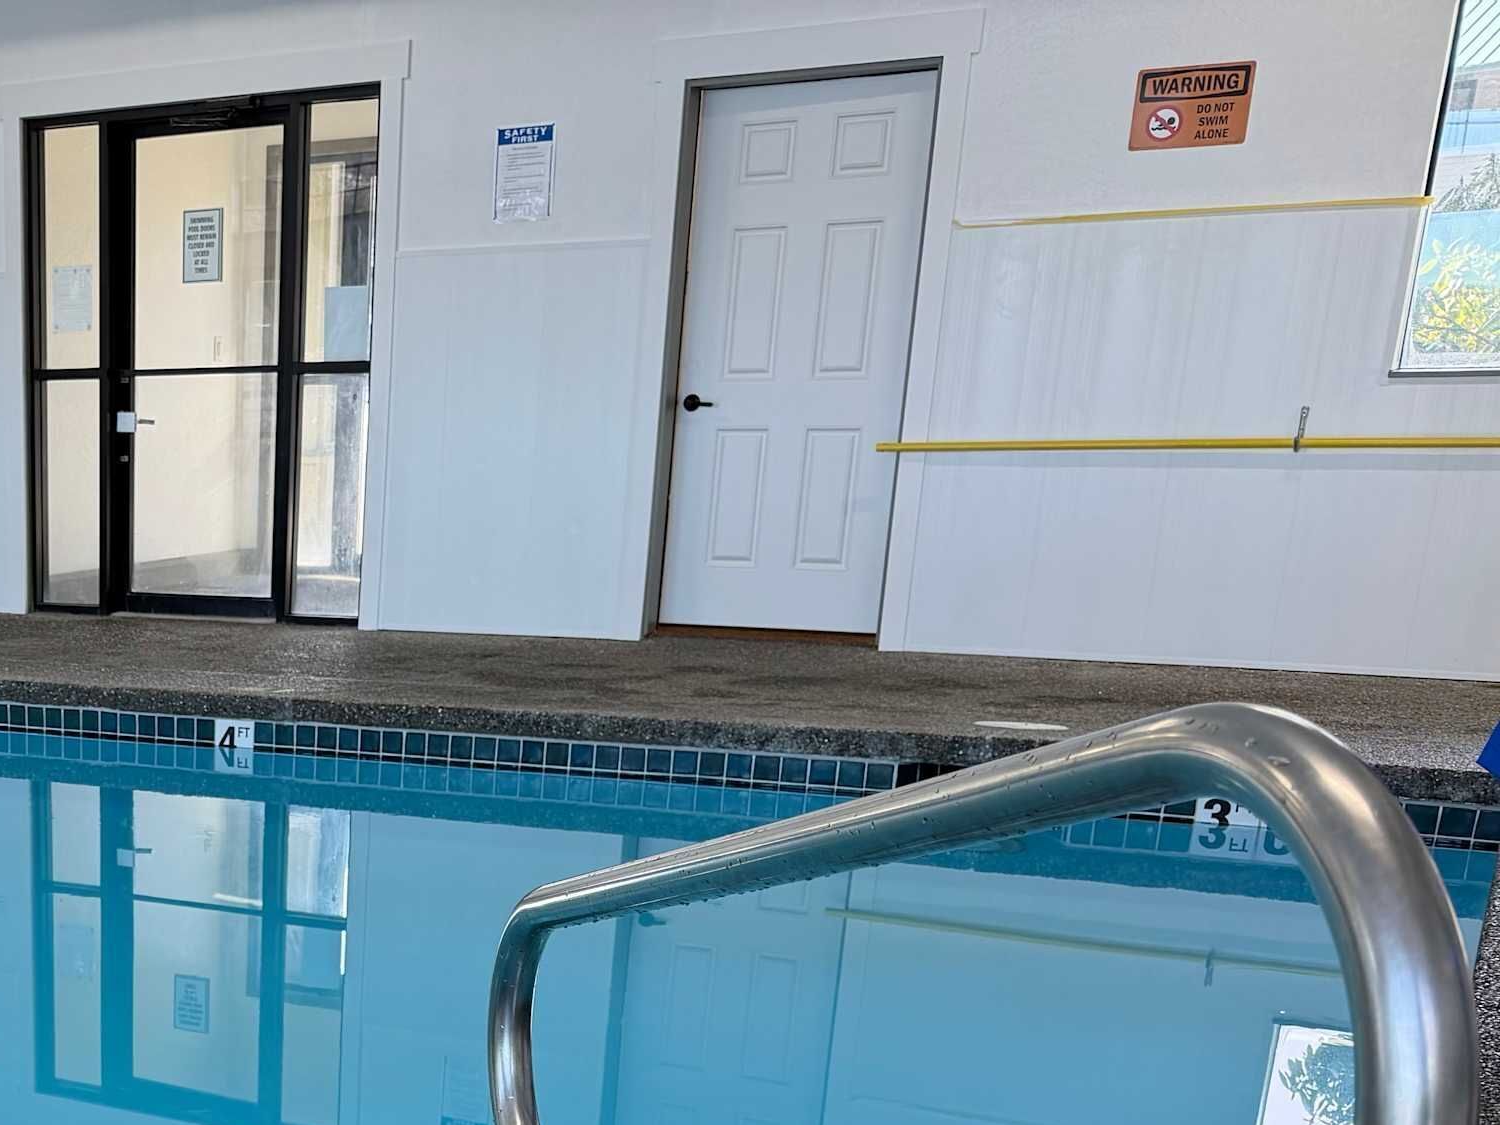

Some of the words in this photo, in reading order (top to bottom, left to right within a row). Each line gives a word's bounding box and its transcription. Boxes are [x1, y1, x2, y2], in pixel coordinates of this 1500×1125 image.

[1153, 73, 1240, 96] WARNING
[1197, 104, 1211, 114] DO
[1213, 102, 1235, 113] NOT
[1198, 115, 1229, 127] SWIM
[504, 127, 548, 140] SAFETY
[511, 134, 539, 144] FIRST
[1194, 128, 1229, 140] ALONE
[218, 726, 237, 748] 4
[237, 727, 250, 738] FT
